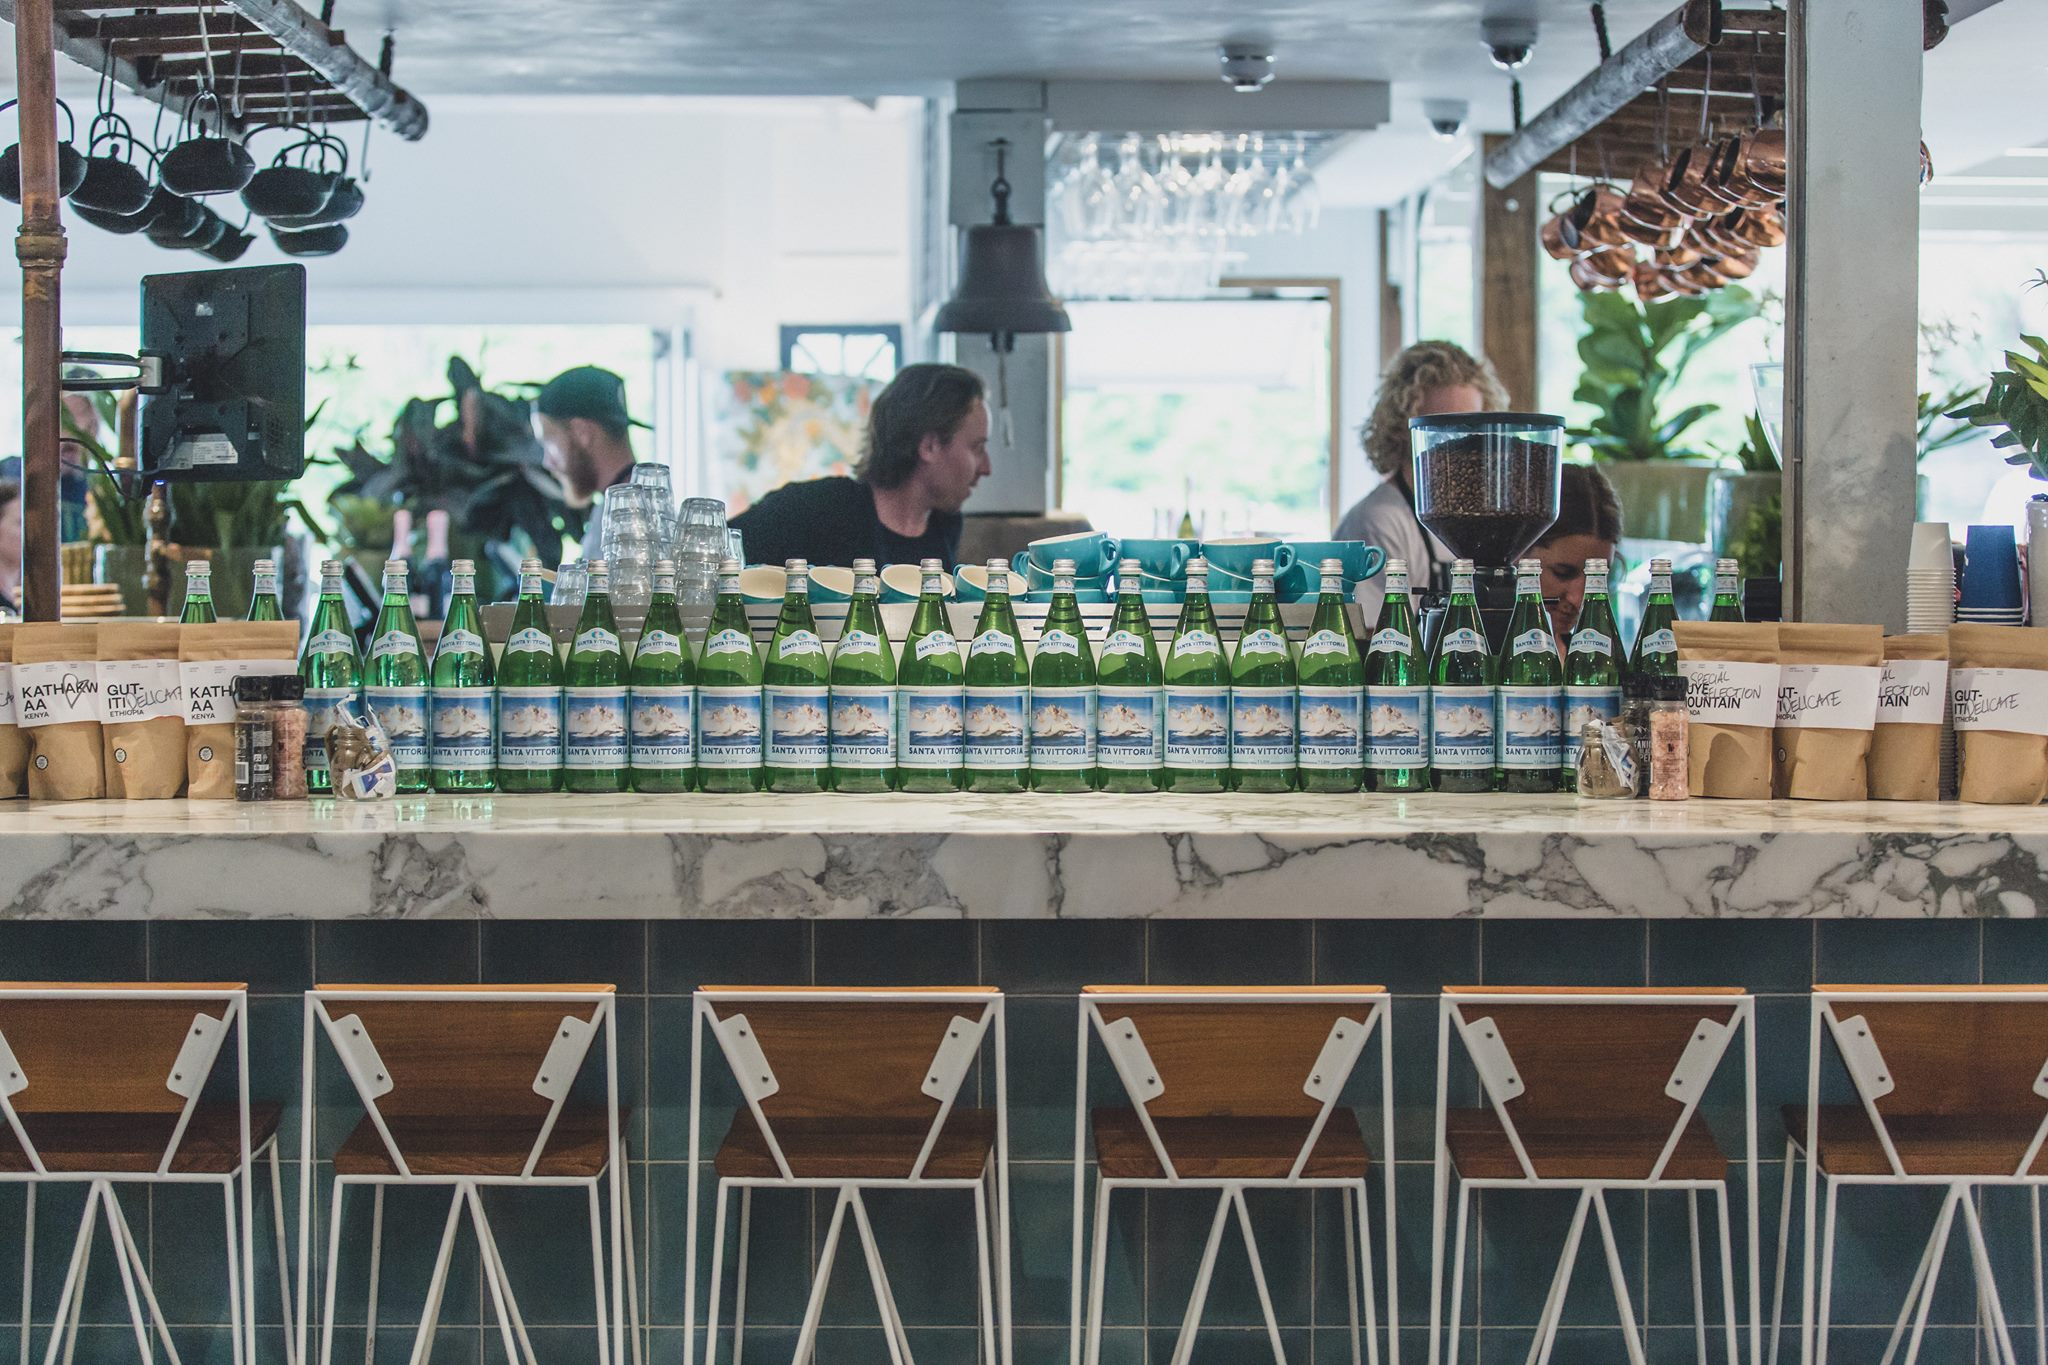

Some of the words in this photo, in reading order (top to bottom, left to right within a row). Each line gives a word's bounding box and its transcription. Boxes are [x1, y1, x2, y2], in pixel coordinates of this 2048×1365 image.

[1690, 671, 1730, 686] SPECIAL
[107, 683, 144, 696] GUT-
[190, 685, 232, 698] KATH
[1686, 684, 1709, 695] UYE
[1778, 687, 1798, 699] UT-
[1879, 682, 1930, 697] LECTION
[1954, 690, 1982, 702] GUT-
[108, 697, 126, 709] ITI
[1686, 697, 1741, 709] OUNTAIN
[1782, 689, 1843, 714] DELICATE
[1878, 695, 1909, 707] TAIN
[1966, 693, 2021, 717] DELICATE
[24, 699, 47, 712] AA
[191, 700, 214, 712] AA
[25, 712, 49, 720] KENYA
[453, 748, 492, 756] VITTORIA
[568, 748, 589, 756] SANTA
[651, 748, 691, 756] VITTORIA
[701, 748, 724, 756] SANTA
[725, 748, 761, 756] VITTORIA
[772, 748, 798, 756] SANTA
[849, 748, 889, 756] VITTORIA
[909, 748, 935, 756] SANTA
[937, 748, 961, 756] VITTOR
[984, 748, 1023, 756] VITTORIA
[1046, 748, 1086, 756] VITTORIA
[1096, 748, 1111, 756] ANTA
[1113, 748, 1153, 756] VITTORIA
[1168, 748, 1190, 756] SANTA
[1192, 748, 1227, 756] VITTORIA
[1233, 748, 1256, 756] SANTA
[1258, 748, 1293, 756] VITTORIA
[1299, 748, 1316, 756] ANTA
[1318, 748, 1357, 756] VITTORIA
[1379, 748, 1419, 756] VITTORIA
[1434, 748, 1458, 756] SANTA
[1505, 748, 1531, 756] SANTA
